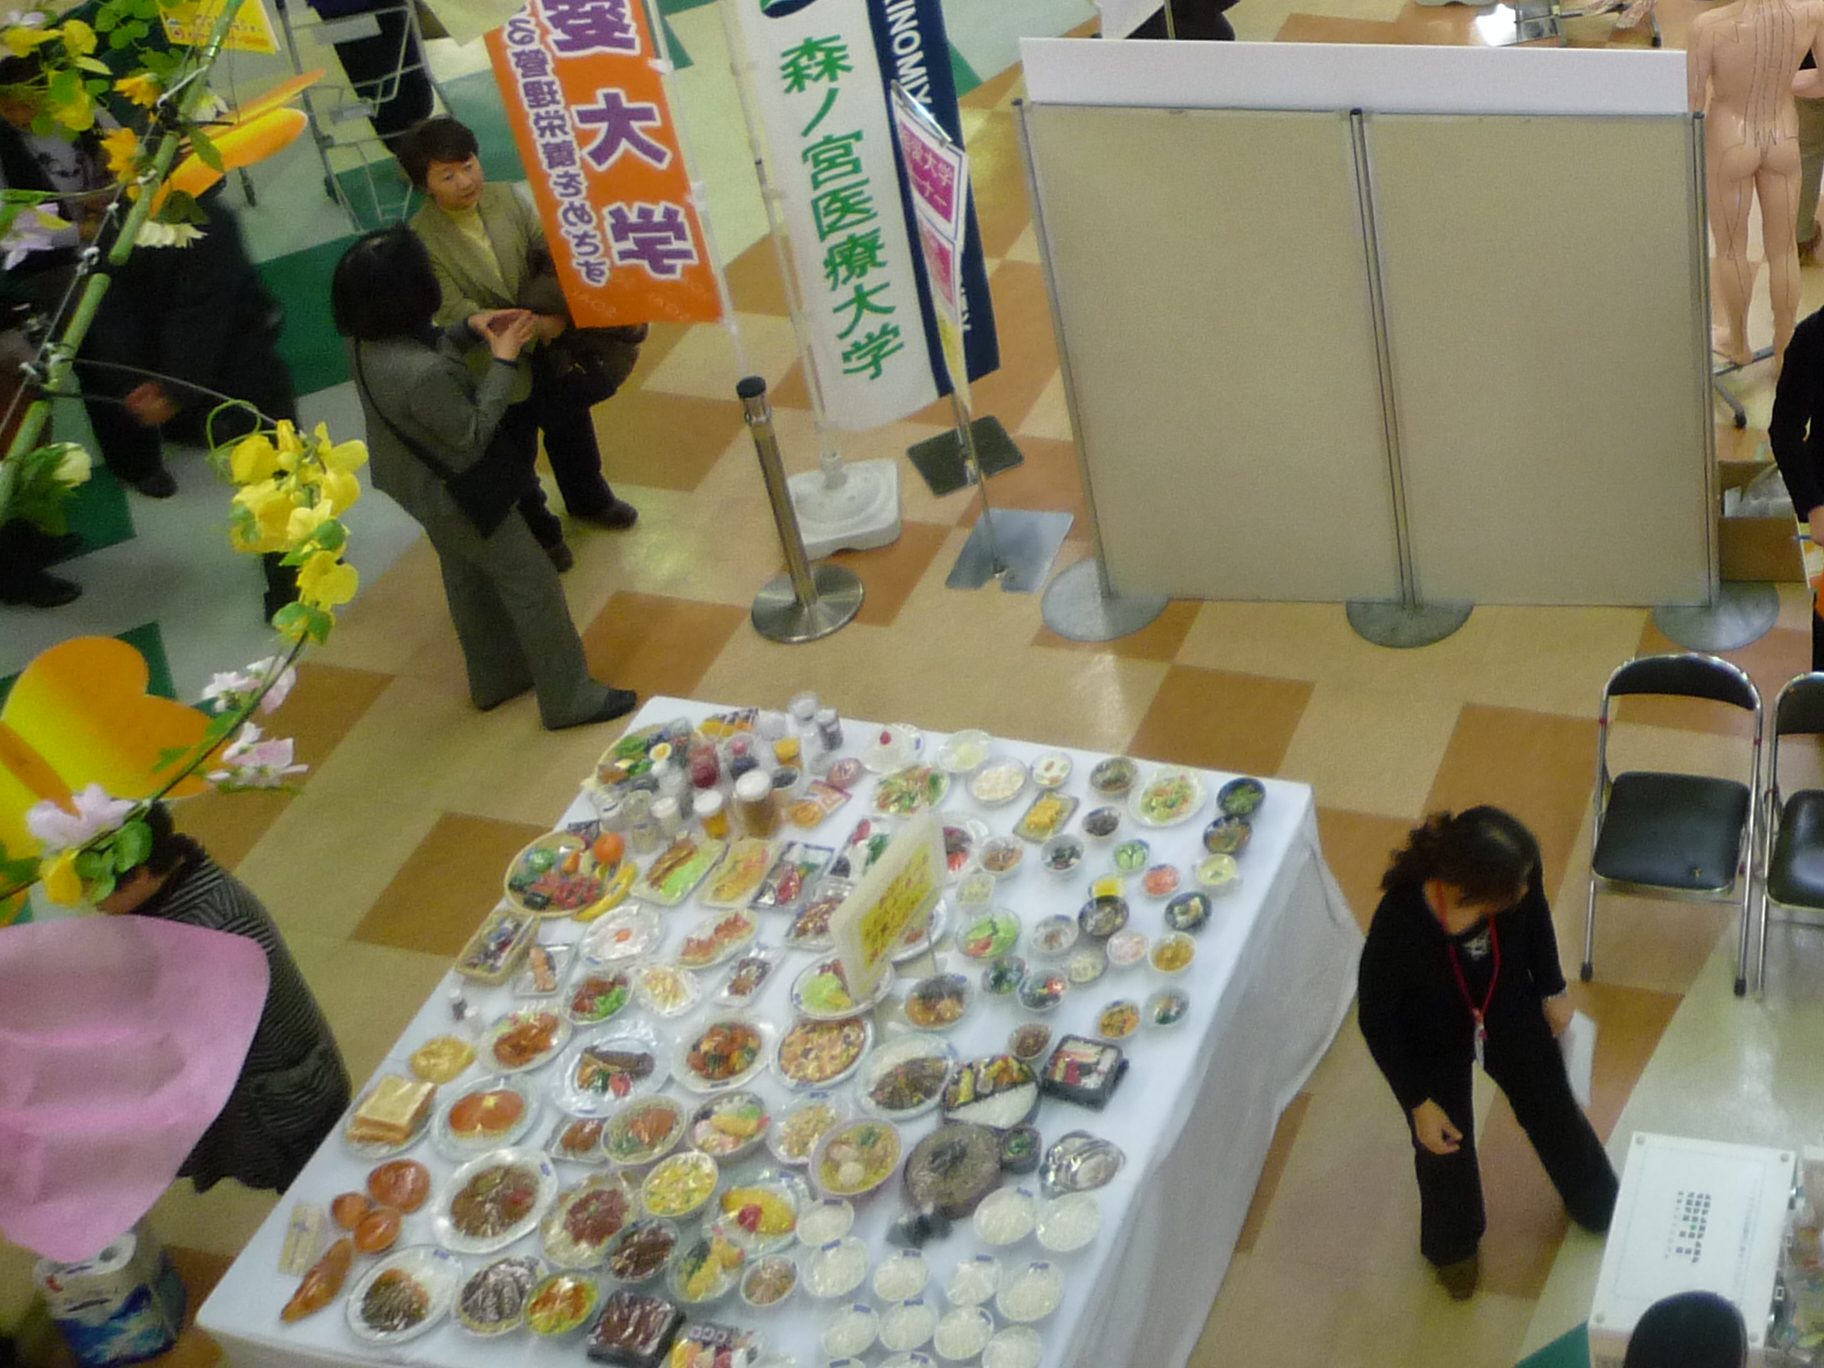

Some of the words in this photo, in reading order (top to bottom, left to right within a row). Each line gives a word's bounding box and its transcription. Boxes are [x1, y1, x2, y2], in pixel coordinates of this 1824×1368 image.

[779, 33, 906, 380] 森ノ宮医療大学
